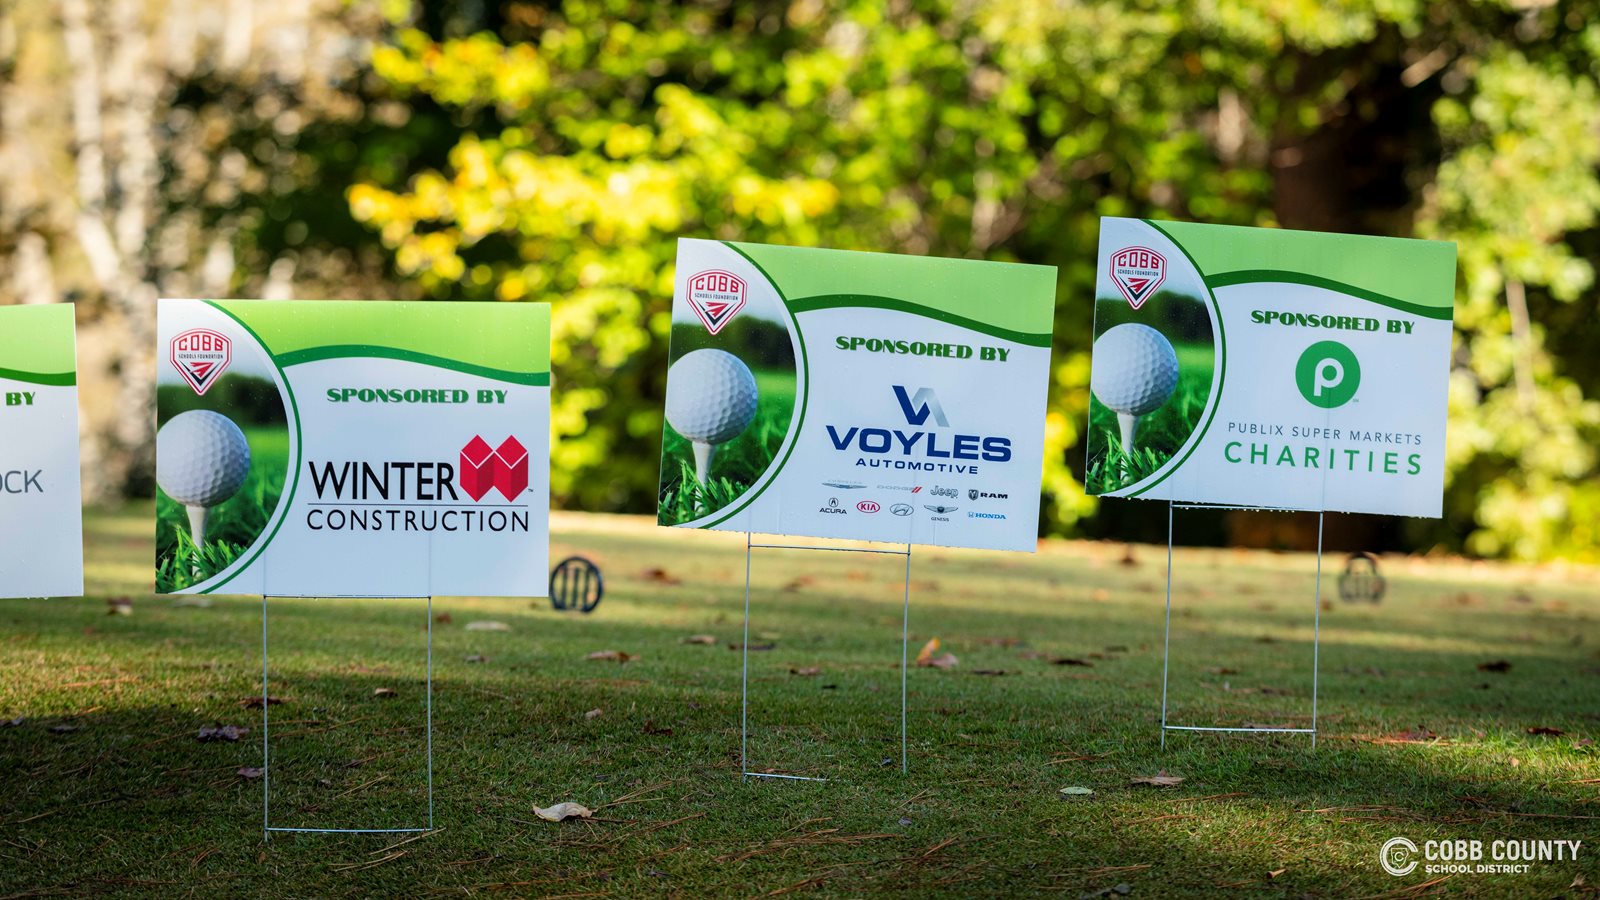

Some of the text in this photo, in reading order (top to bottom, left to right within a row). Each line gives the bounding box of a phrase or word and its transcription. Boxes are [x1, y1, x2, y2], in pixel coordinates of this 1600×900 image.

[1118, 252, 1159, 269] COBB
[695, 275, 739, 293] COBB
[1251, 310, 1415, 334] SPONSORED BY
[179, 335, 223, 351] COBB
[836, 336, 1011, 362] SPONSORED BY
[6, 391, 36, 406] BY
[326, 388, 508, 404] SPONSORED BY
[1228, 422, 1422, 446] PUBLIX SUPER MARKETS
[825, 425, 1012, 463] VOYLES
[855, 458, 979, 475] AUTOMOTIVE
[1224, 441, 1422, 476] CHARITIES
[0, 469, 44, 494] CK
[308, 461, 459, 500] WINTER
[930, 485, 959, 499] Jeep
[819, 507, 847, 515] ACURA
[860, 503, 876, 511] KIA
[306, 509, 530, 533] CONSTRUCTION
[975, 512, 1007, 520] HONDA
